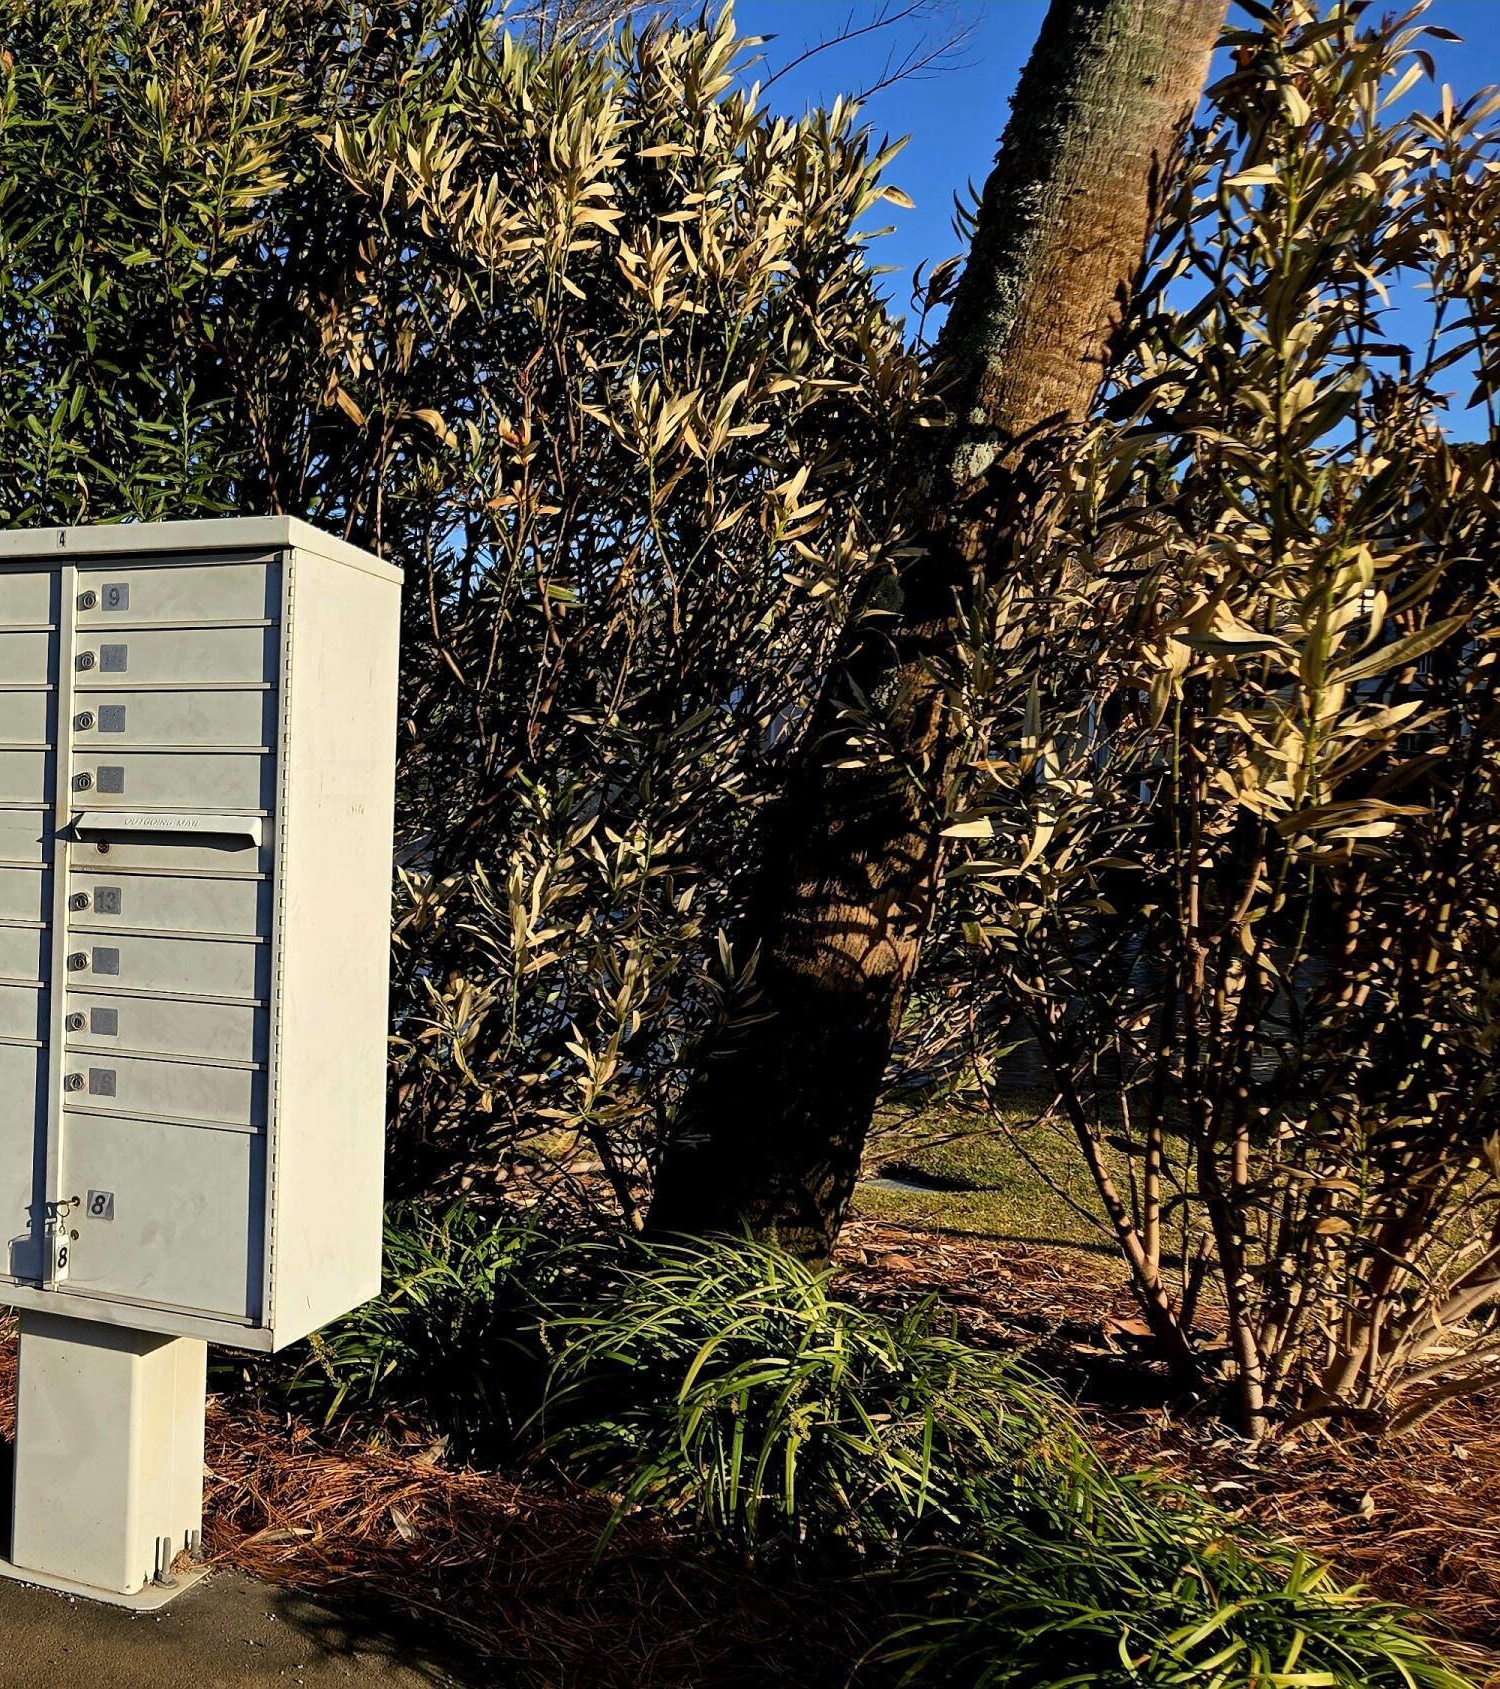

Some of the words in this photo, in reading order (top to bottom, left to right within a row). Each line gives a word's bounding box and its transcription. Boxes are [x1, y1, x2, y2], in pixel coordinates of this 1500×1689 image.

[59, 531, 65, 548] 4
[109, 587, 120, 607] 9
[97, 891, 117, 911] 13
[91, 1195, 105, 1215] 8
[57, 1246, 68, 1268] 8
